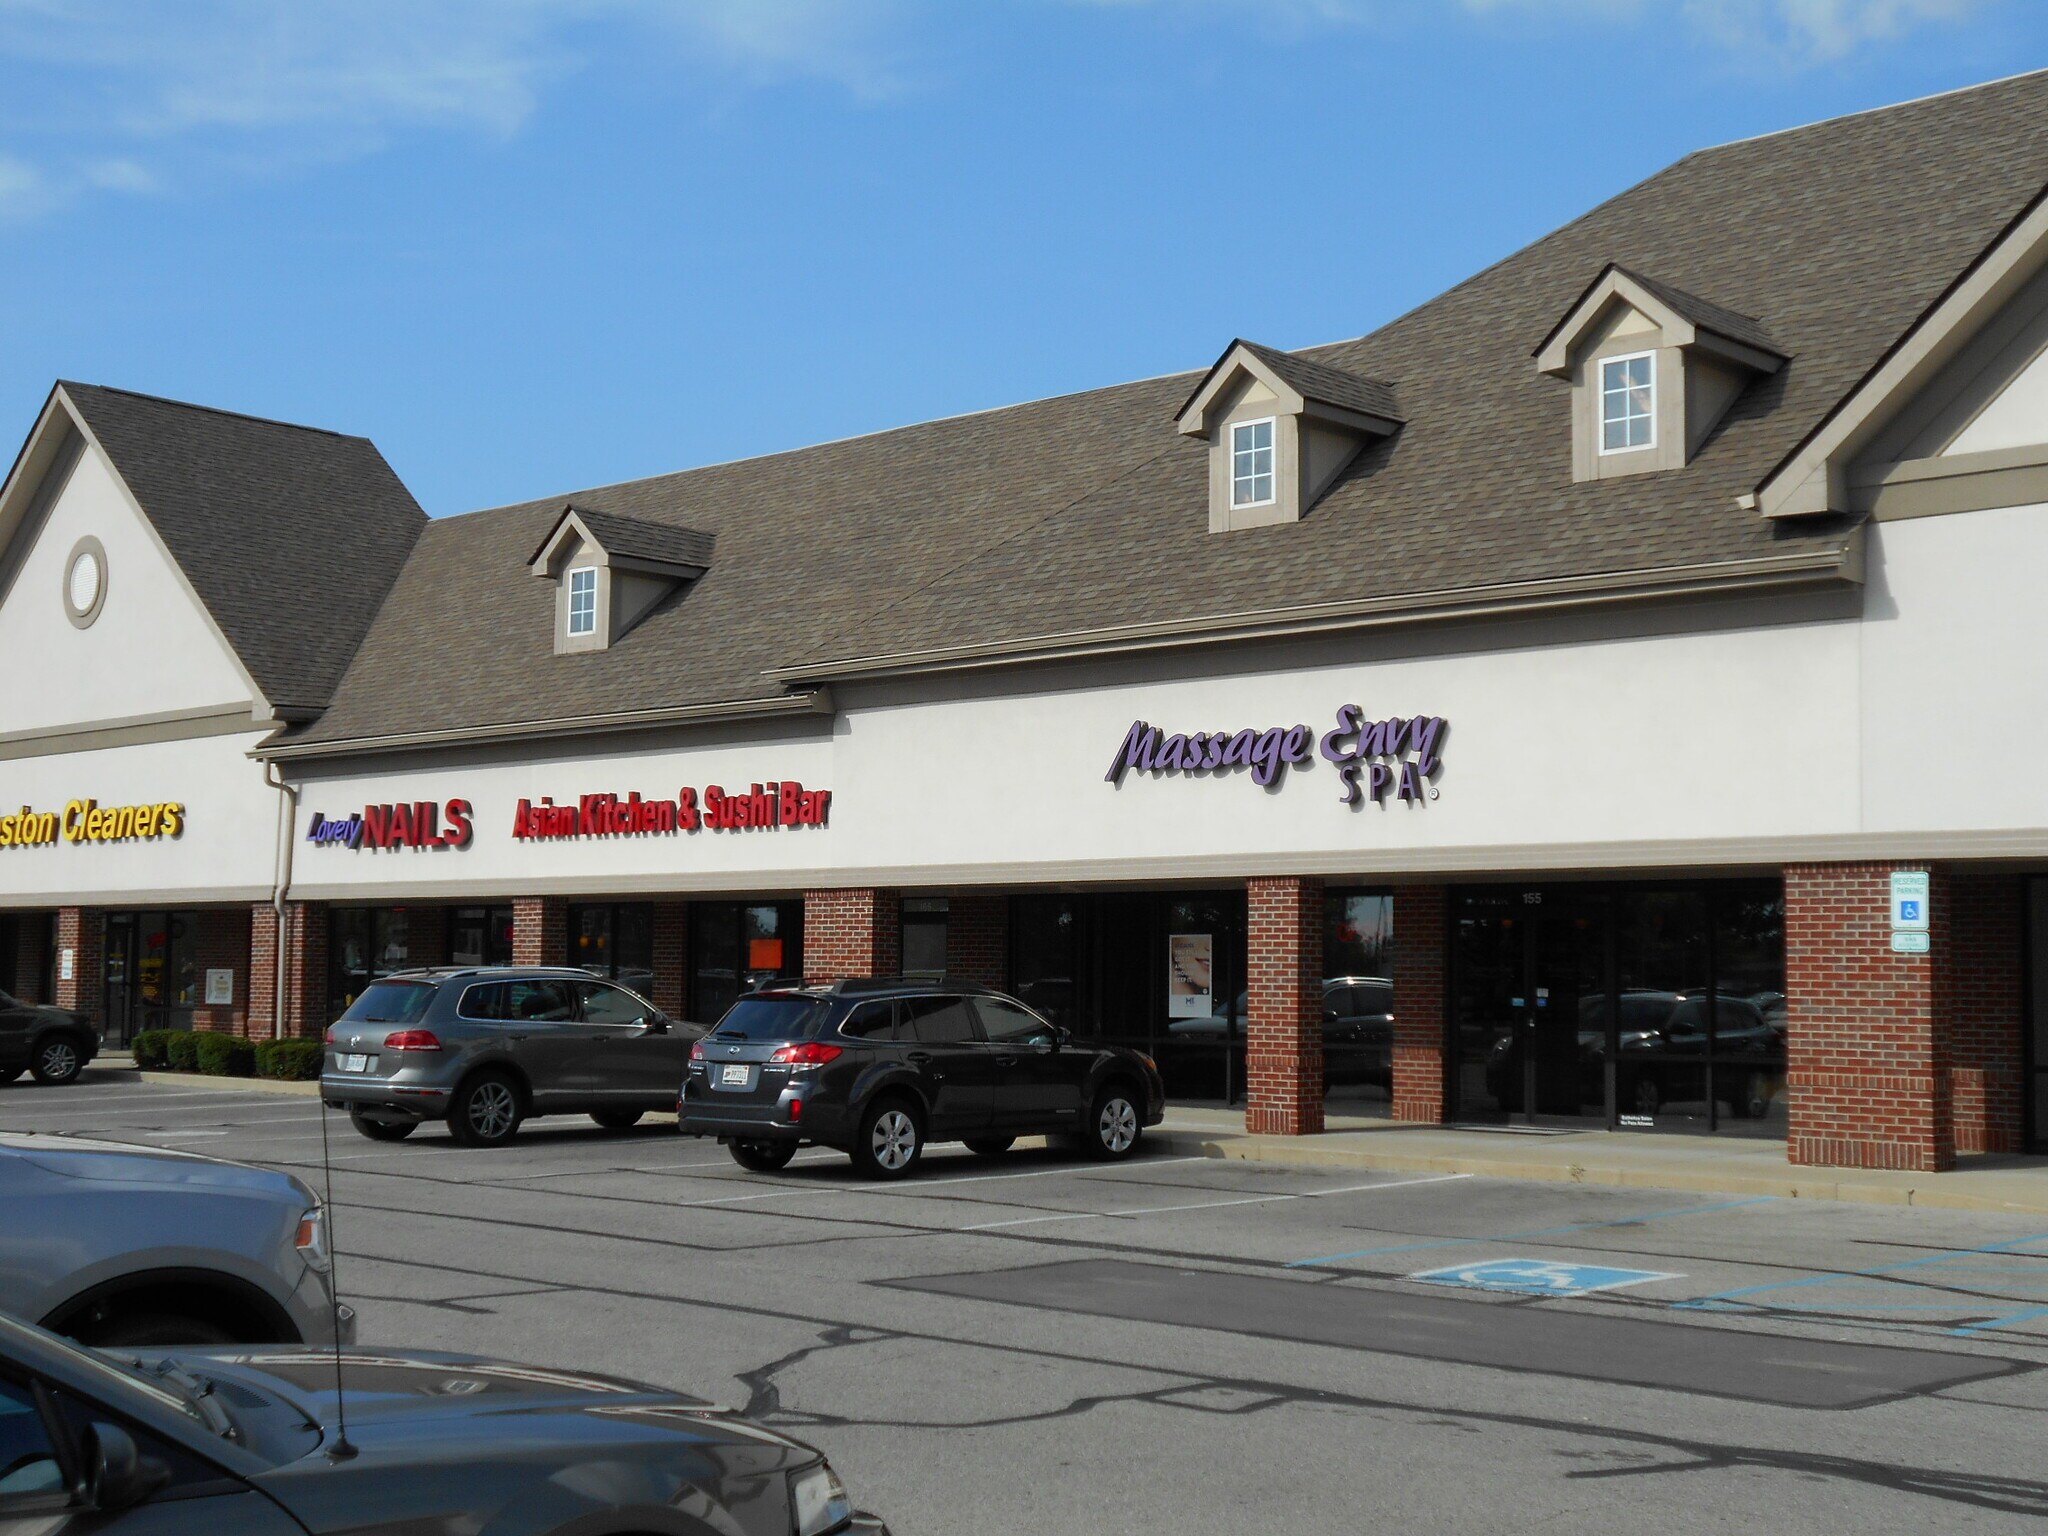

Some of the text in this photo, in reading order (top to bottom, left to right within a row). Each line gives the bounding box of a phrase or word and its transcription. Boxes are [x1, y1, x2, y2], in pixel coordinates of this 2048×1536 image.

[1104, 703, 1446, 786] Massage Envy
[1339, 761, 1422, 803] SPA
[62, 799, 184, 841] Cleaners
[306, 799, 474, 850] Lovely NAILS
[512, 781, 832, 838] Asian Kitchen & Sushi Bar
[1522, 892, 1542, 904] 155
[1894, 877, 1925, 885] RESERVED
[1896, 887, 1924, 895] PARKING
